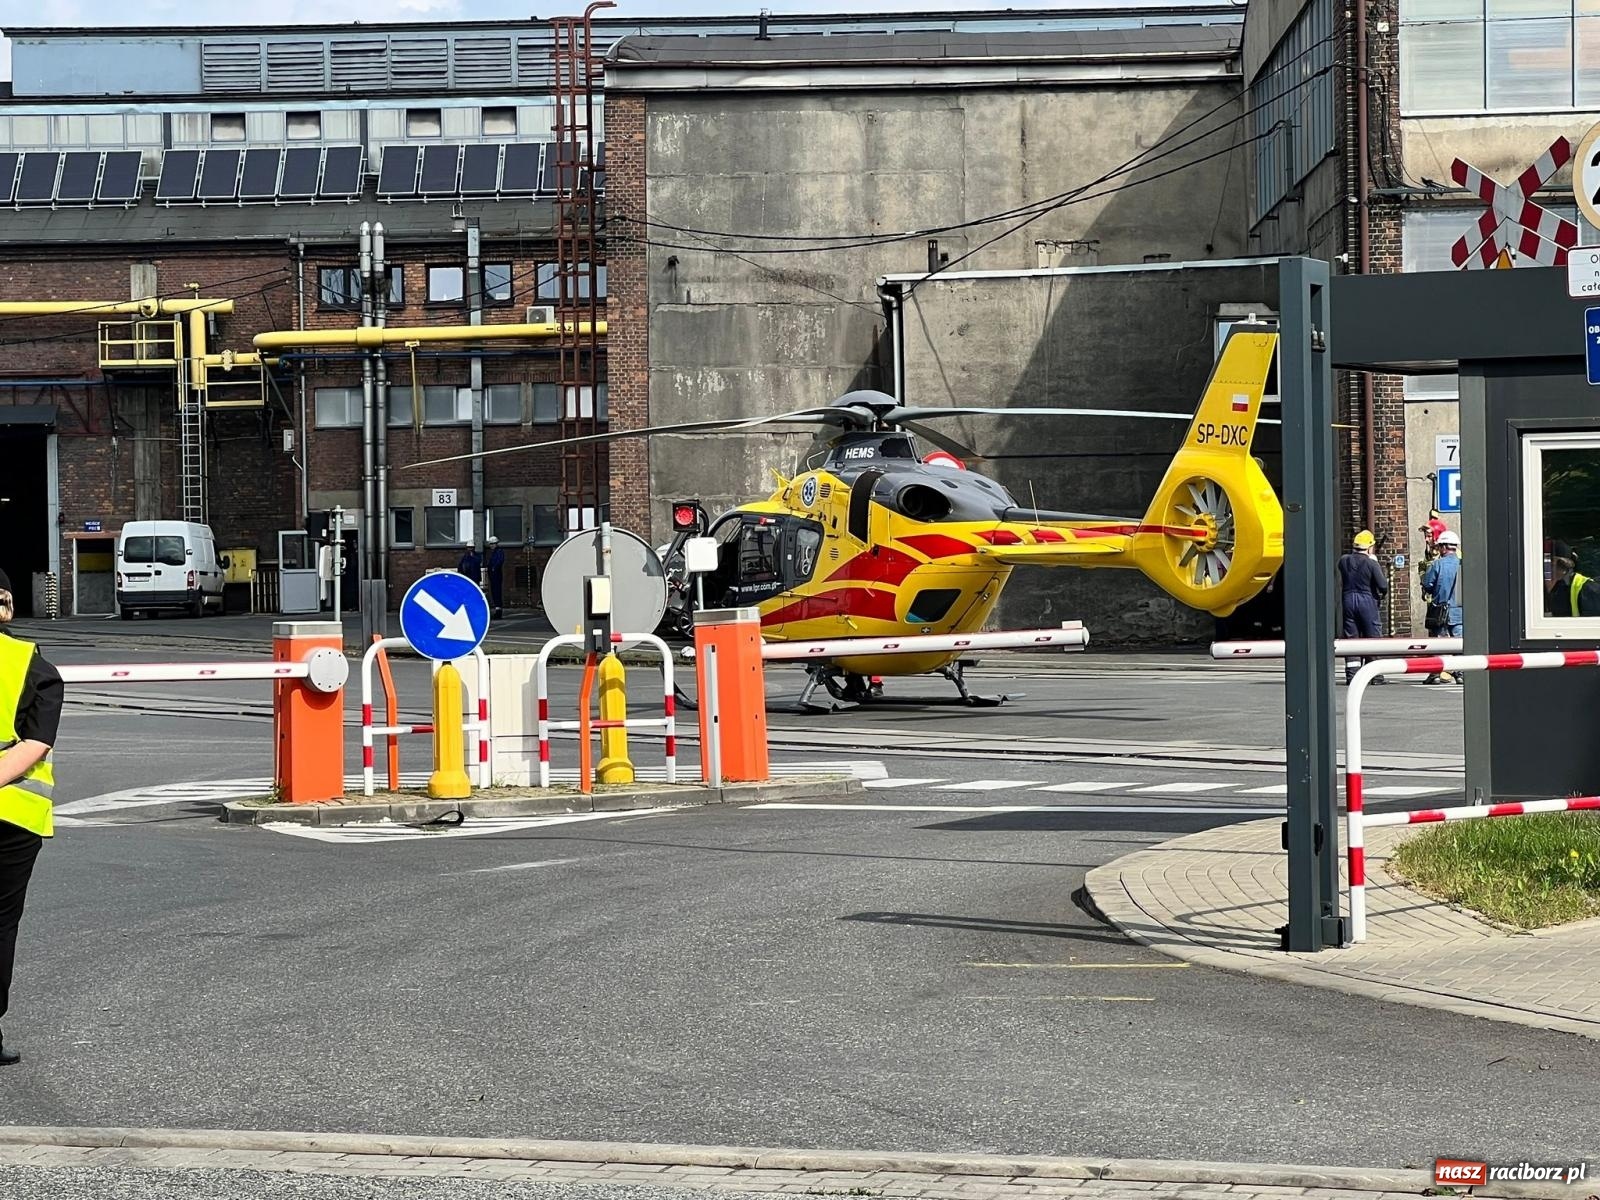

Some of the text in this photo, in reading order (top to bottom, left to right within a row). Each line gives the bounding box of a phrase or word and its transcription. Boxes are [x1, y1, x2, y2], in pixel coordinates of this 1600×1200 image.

[1590, 254, 1600, 264] O
[1588, 325, 1600, 334] OB
[1196, 423, 1248, 446] SP-DXC
[844, 447, 875, 459] HEMS
[1446, 445, 1460, 462] 7
[438, 494, 452, 504] 83
